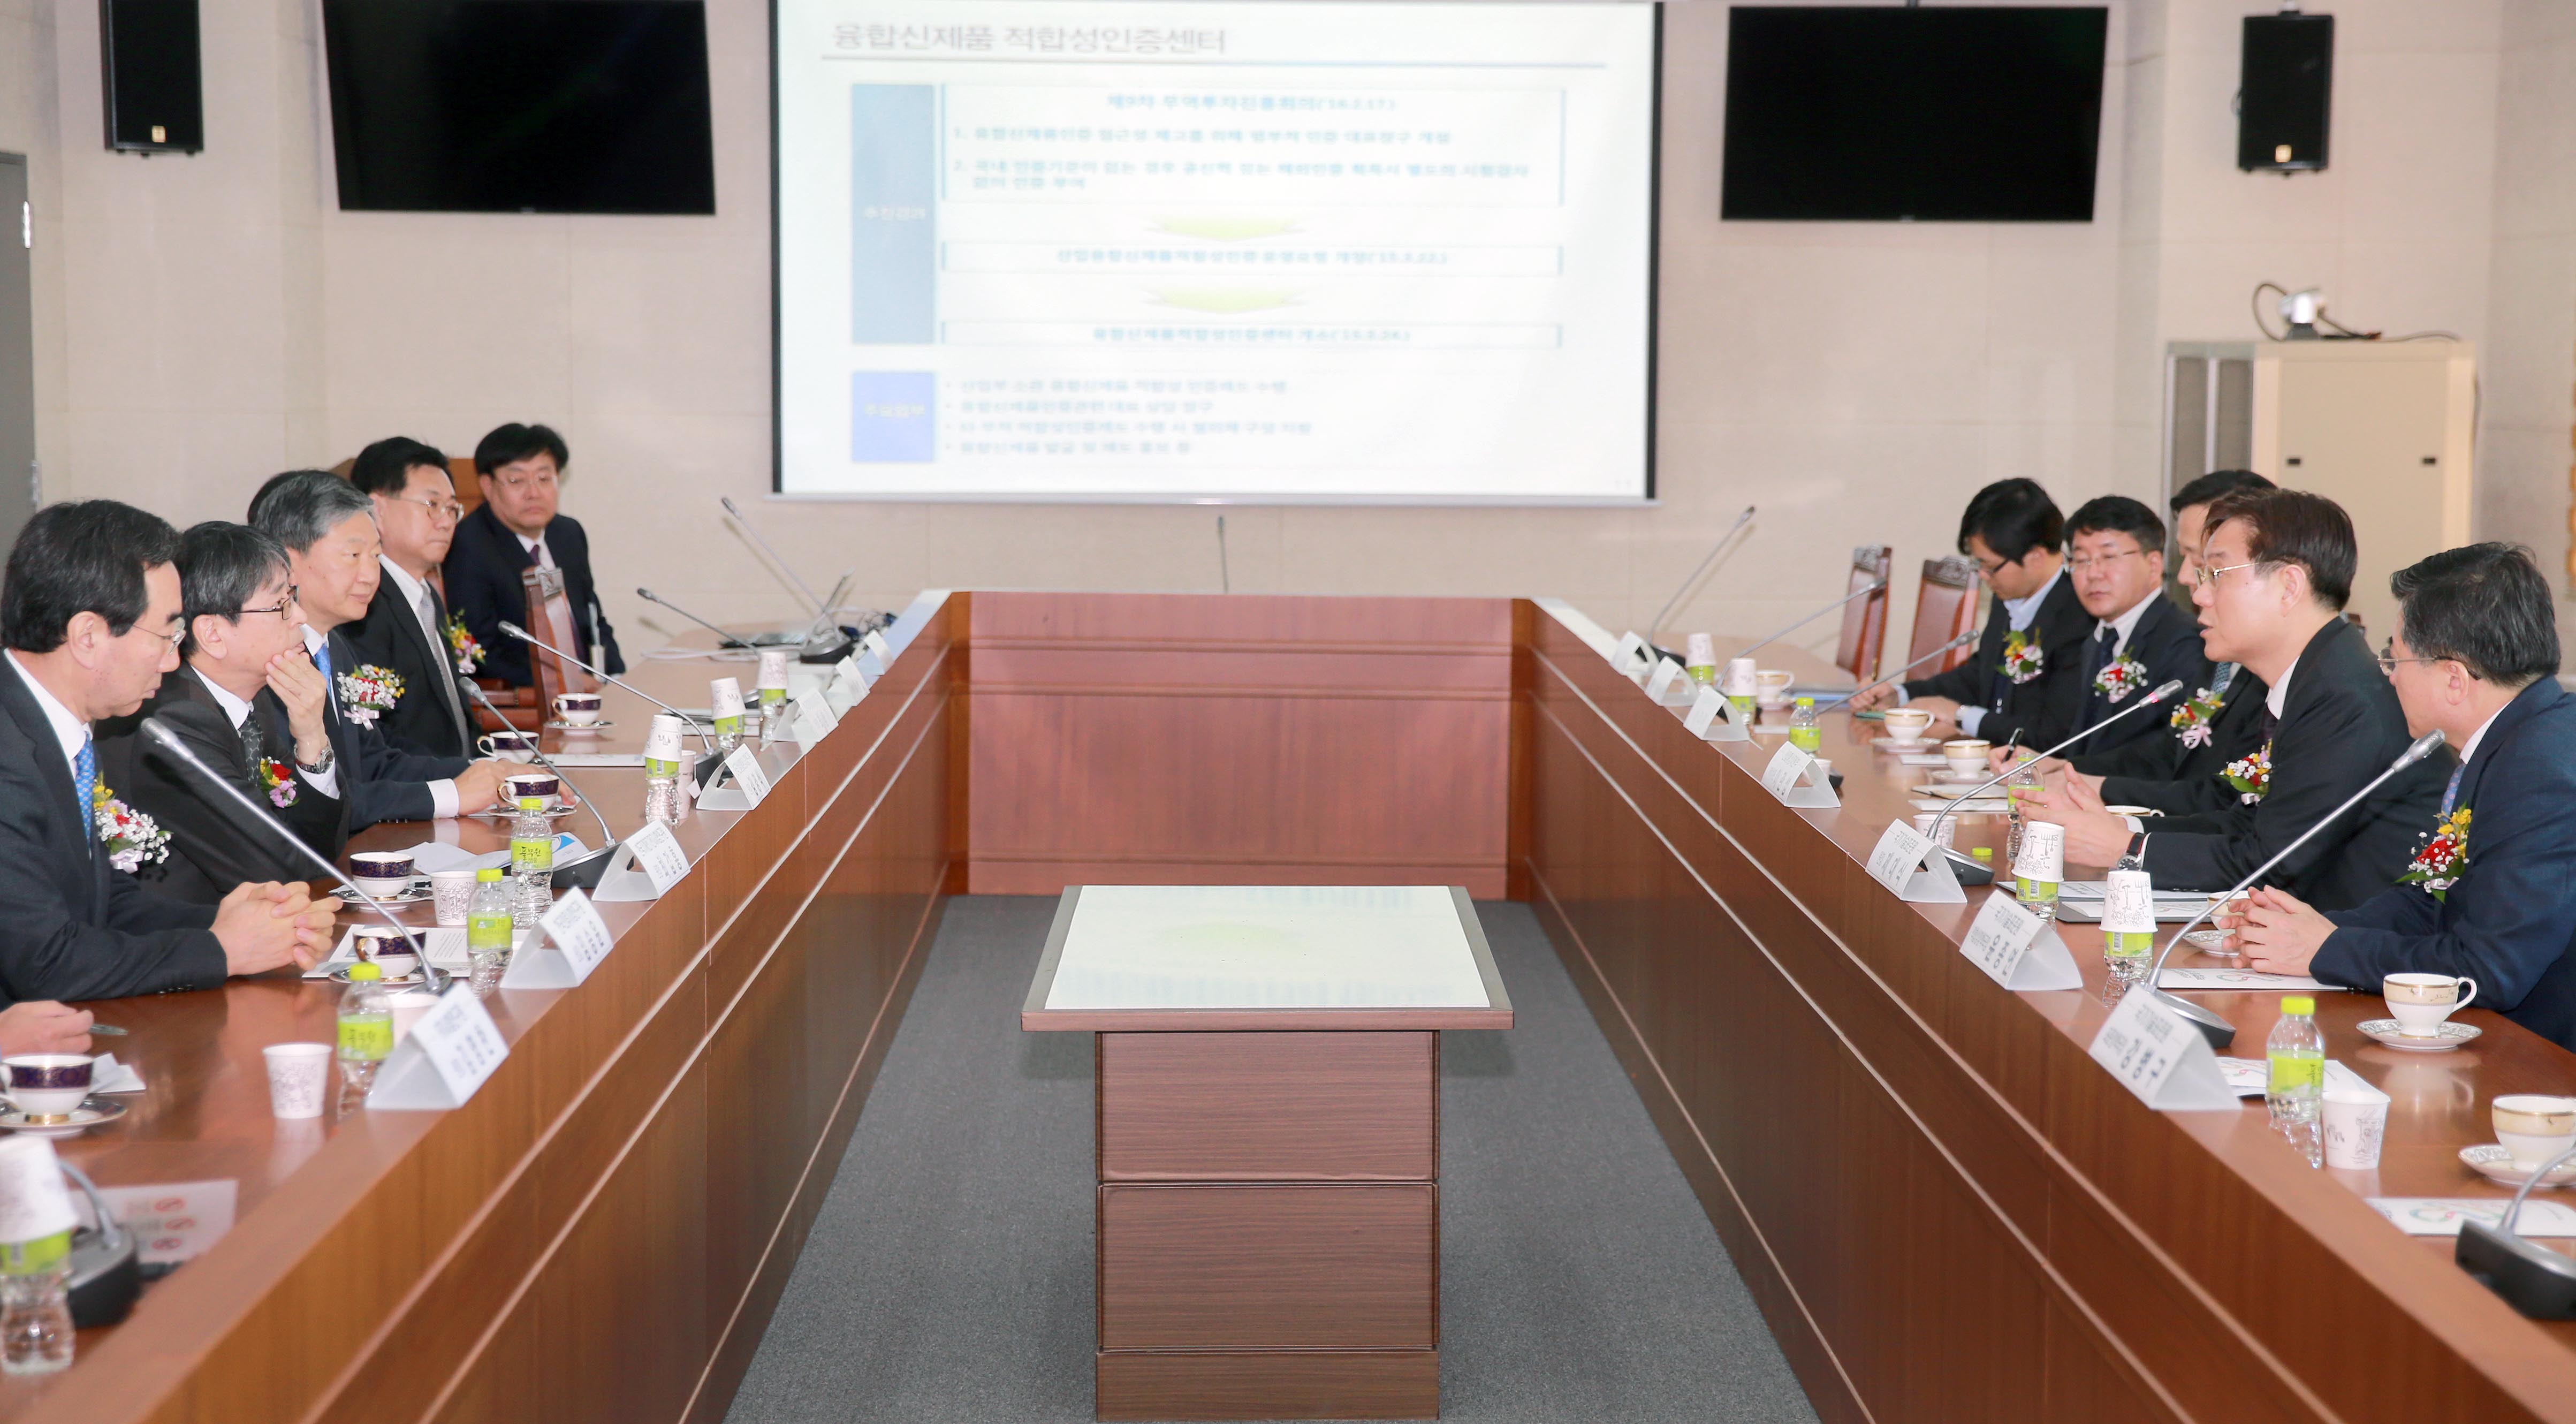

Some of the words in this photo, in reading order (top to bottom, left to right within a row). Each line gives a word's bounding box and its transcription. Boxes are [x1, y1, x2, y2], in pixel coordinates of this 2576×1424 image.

[833, 24, 994, 51] 융합신제품
[1004, 26, 1225, 54] 적합성인증센터
[519, 846, 542, 861] 풀무원
